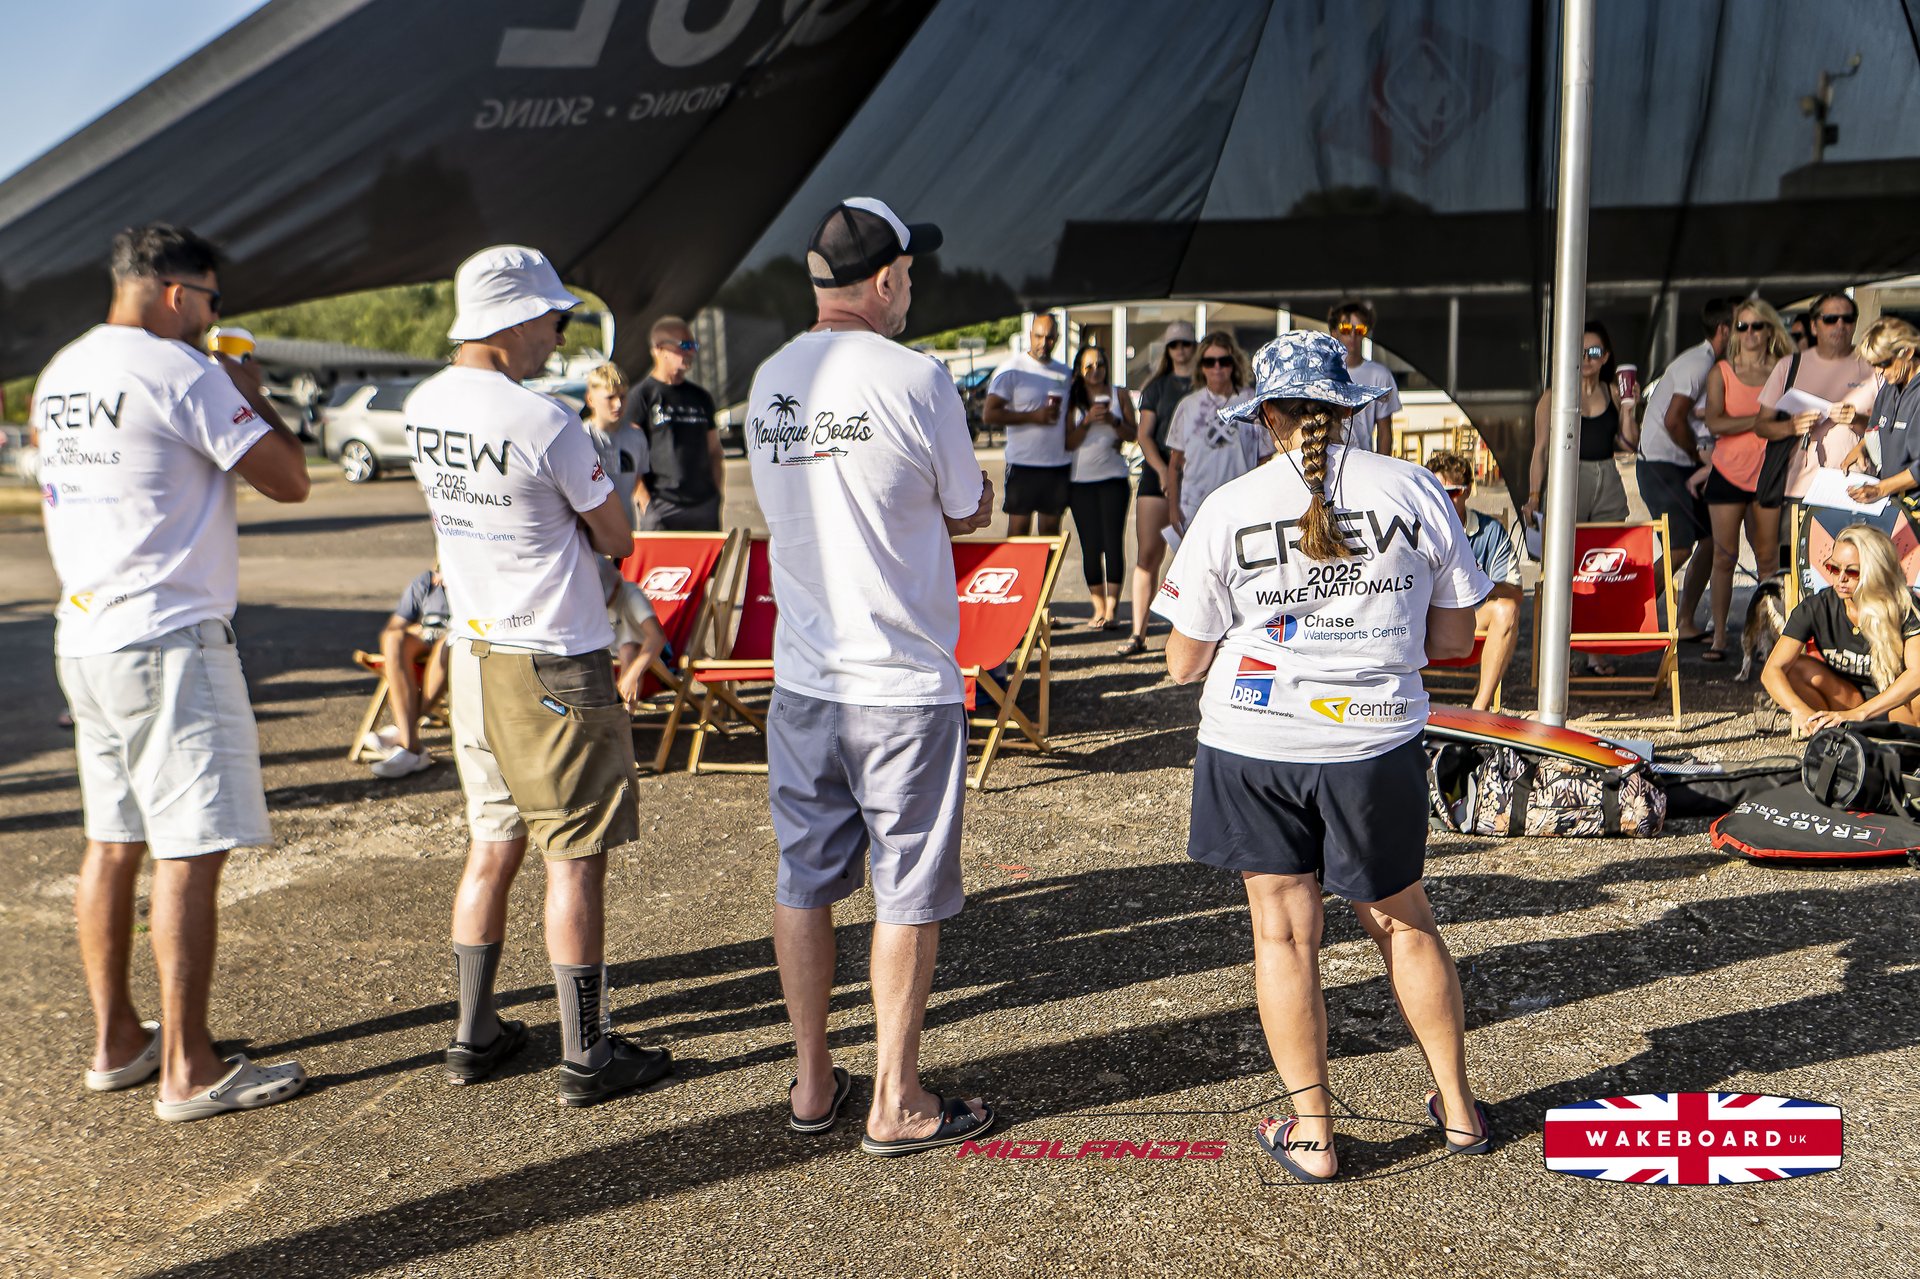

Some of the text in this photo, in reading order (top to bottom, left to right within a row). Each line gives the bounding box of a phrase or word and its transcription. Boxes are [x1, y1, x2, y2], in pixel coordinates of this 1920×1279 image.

[811, 411, 875, 447] Boats
[406, 424, 513, 476] REW
[436, 473, 467, 491] 2025
[442, 489, 513, 507] NATIONALS
[441, 515, 474, 529] Chase
[487, 532, 517, 542] Centre
[1307, 562, 1363, 586] 2025
[1256, 574, 1414, 606] WAKE NATIONALS
[1304, 614, 1355, 629] Chase
[1304, 625, 1407, 642] Watersports Centre
[1232, 685, 1262, 705] DBP
[1348, 698, 1408, 717] central
[1735, 806, 1873, 841] FRAGILE
